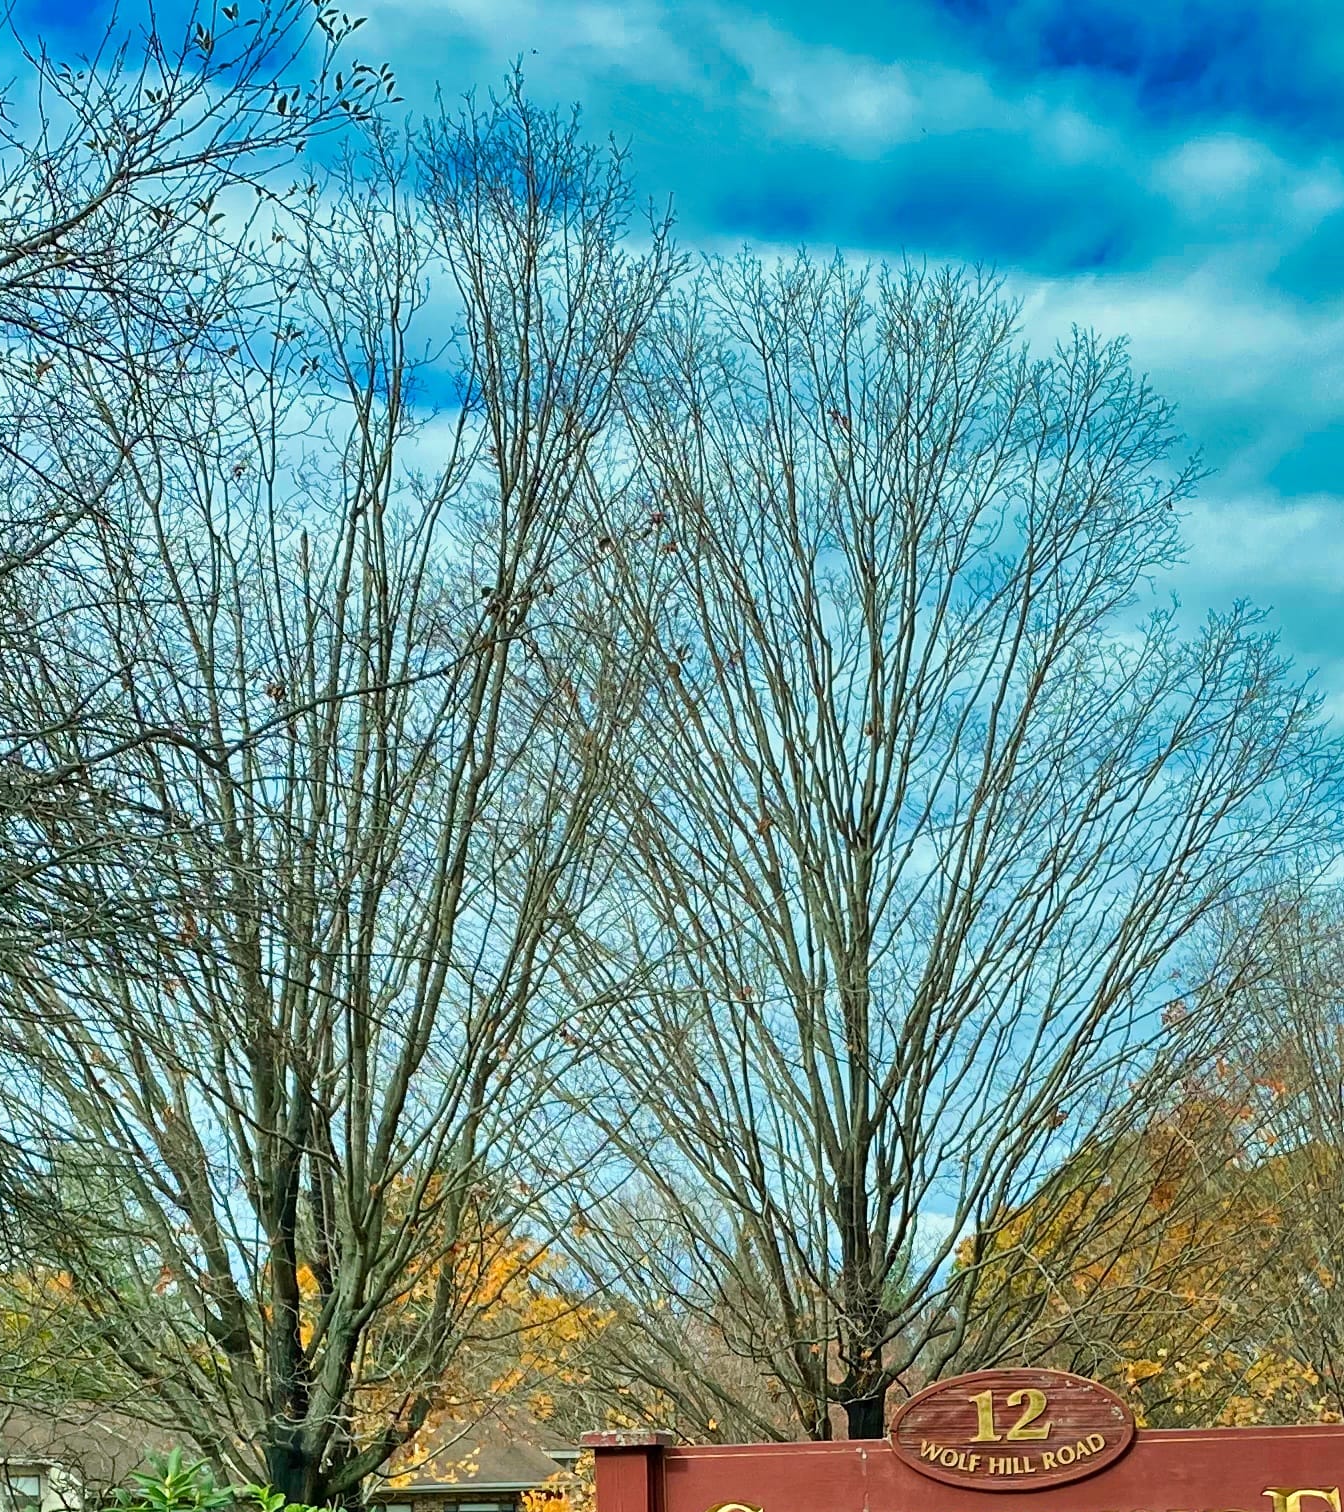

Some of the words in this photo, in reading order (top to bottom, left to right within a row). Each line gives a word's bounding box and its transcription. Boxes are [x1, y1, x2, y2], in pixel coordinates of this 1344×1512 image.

[968, 1388, 1053, 1442] 12
[919, 1438, 982, 1473] WOLF
[988, 1456, 1036, 1475] HILL
[1041, 1433, 1106, 1470] ROAD
